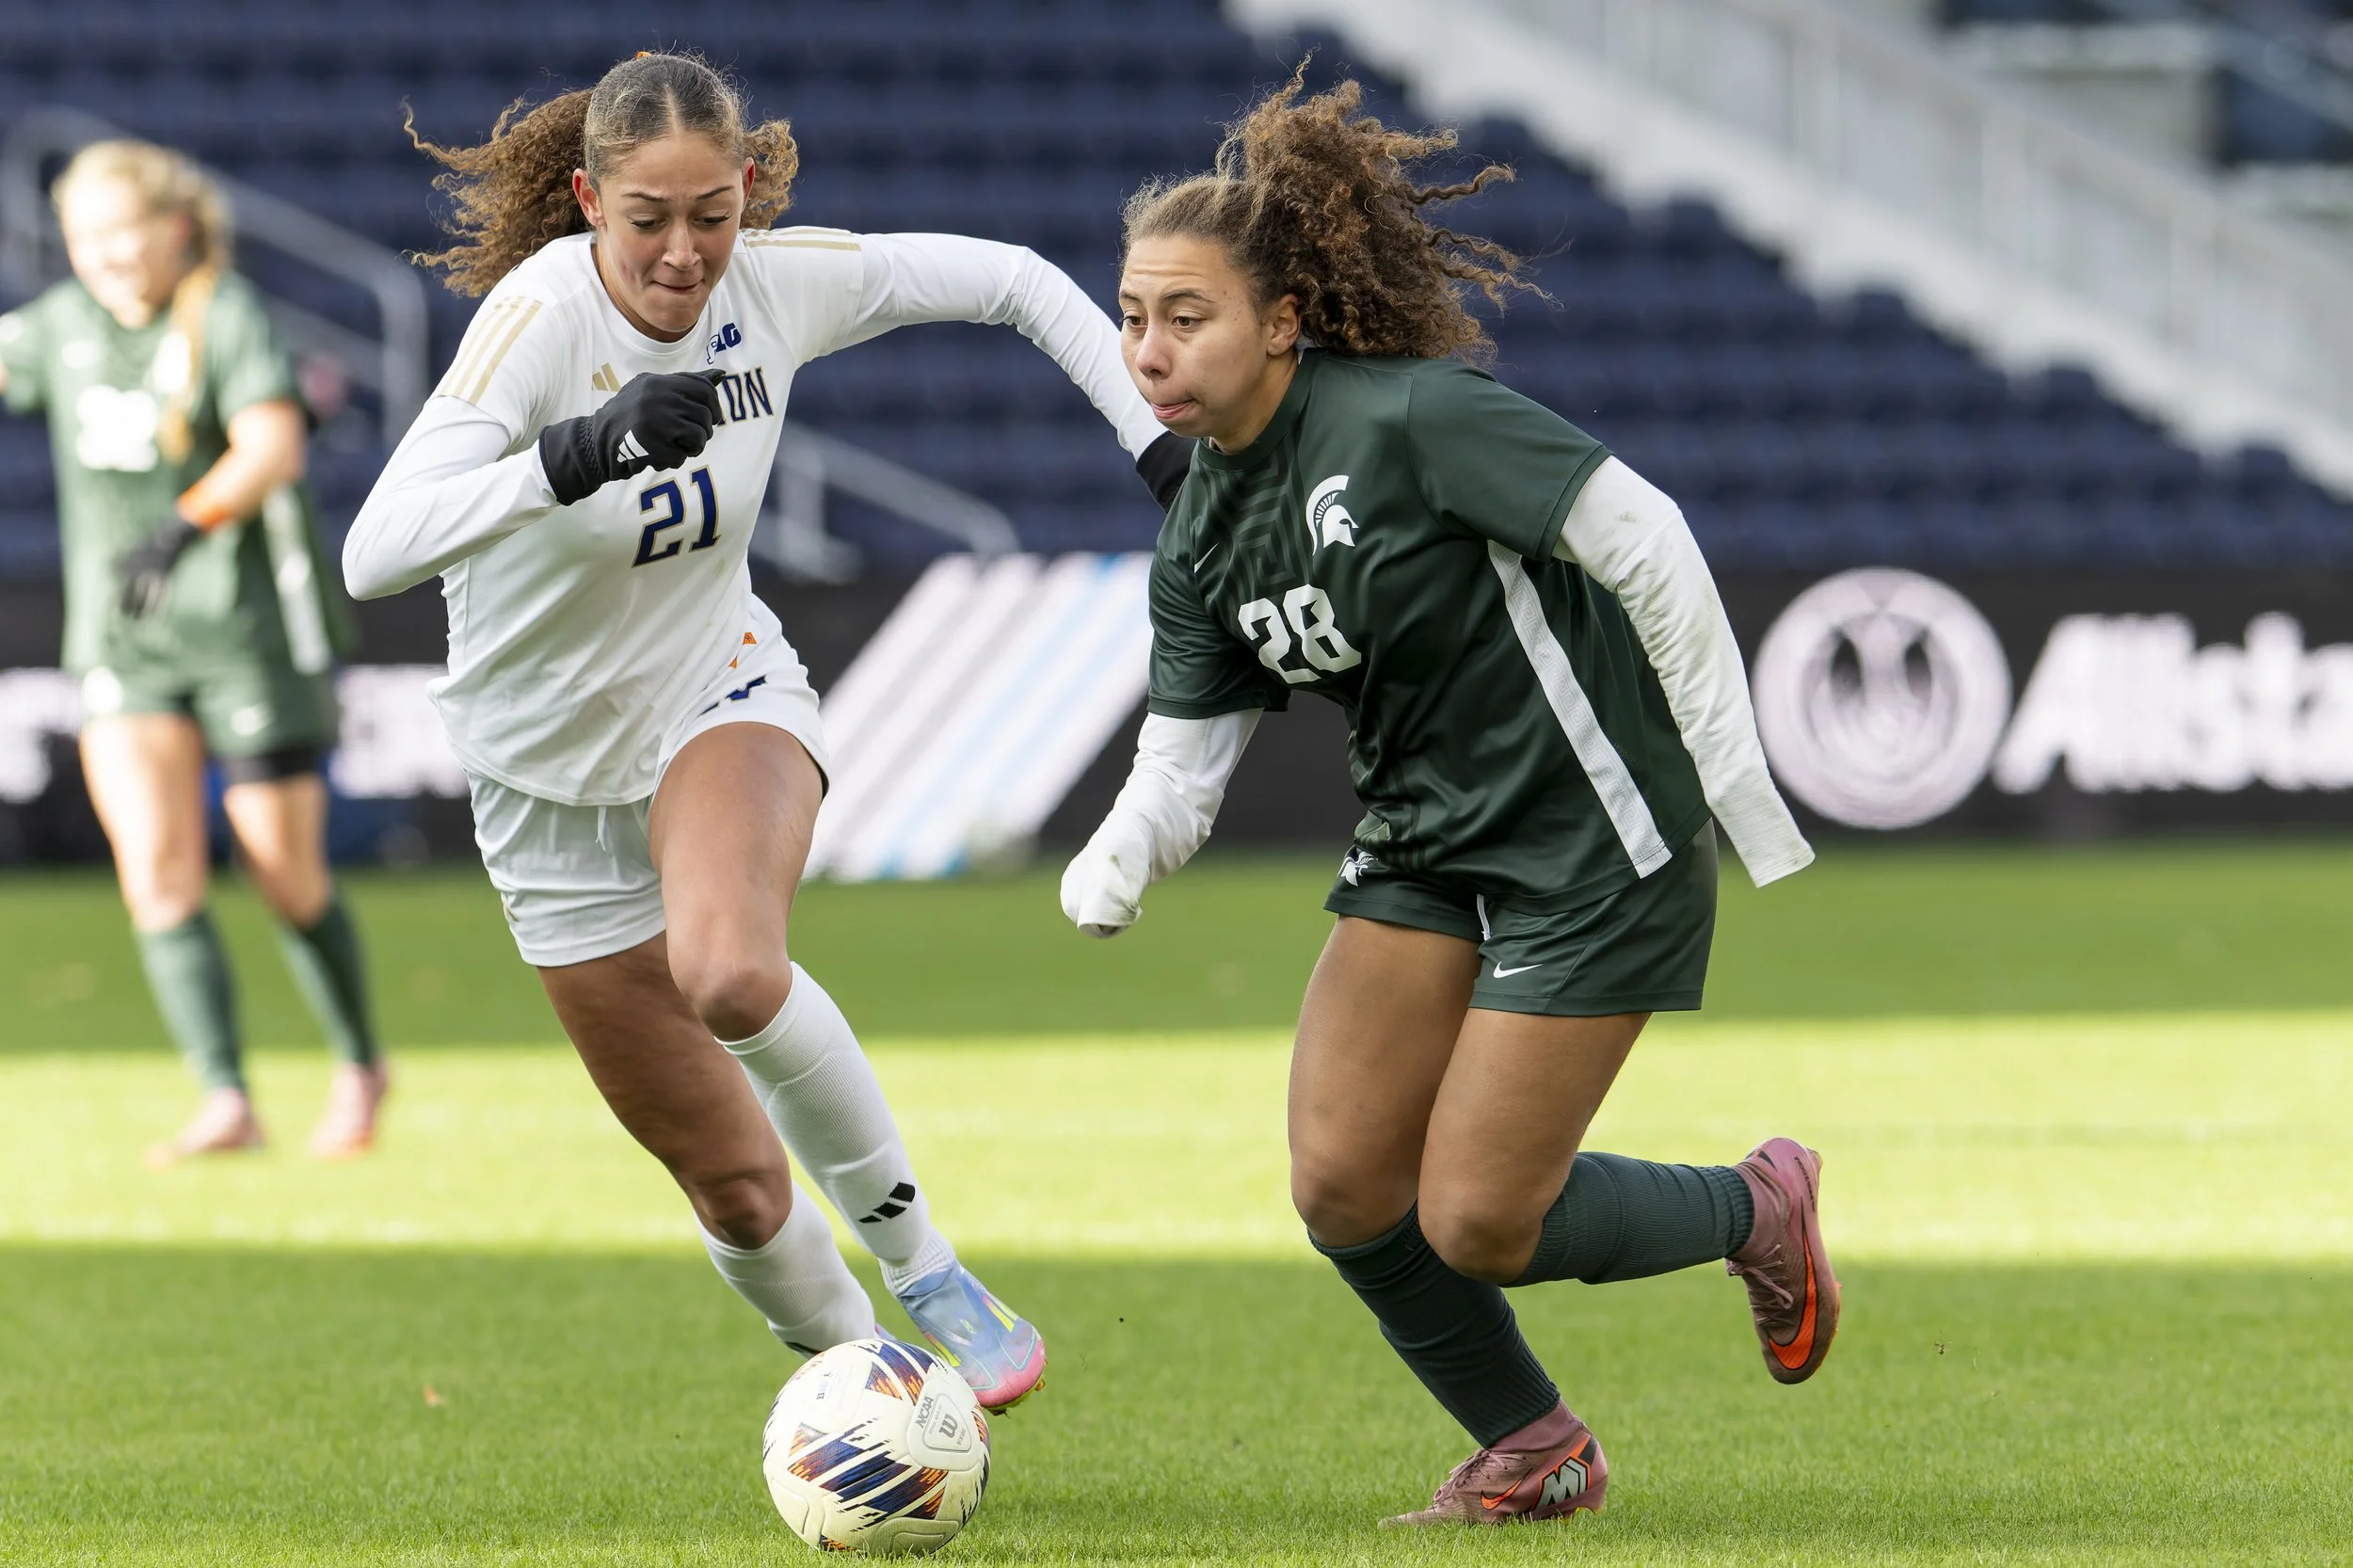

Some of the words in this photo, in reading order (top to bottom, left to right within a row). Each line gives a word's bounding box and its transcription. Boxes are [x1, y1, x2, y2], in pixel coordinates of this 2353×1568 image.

[632, 465, 721, 568] 21
[1238, 584, 1362, 684] 28
[916, 1395, 935, 1429] NCAA
